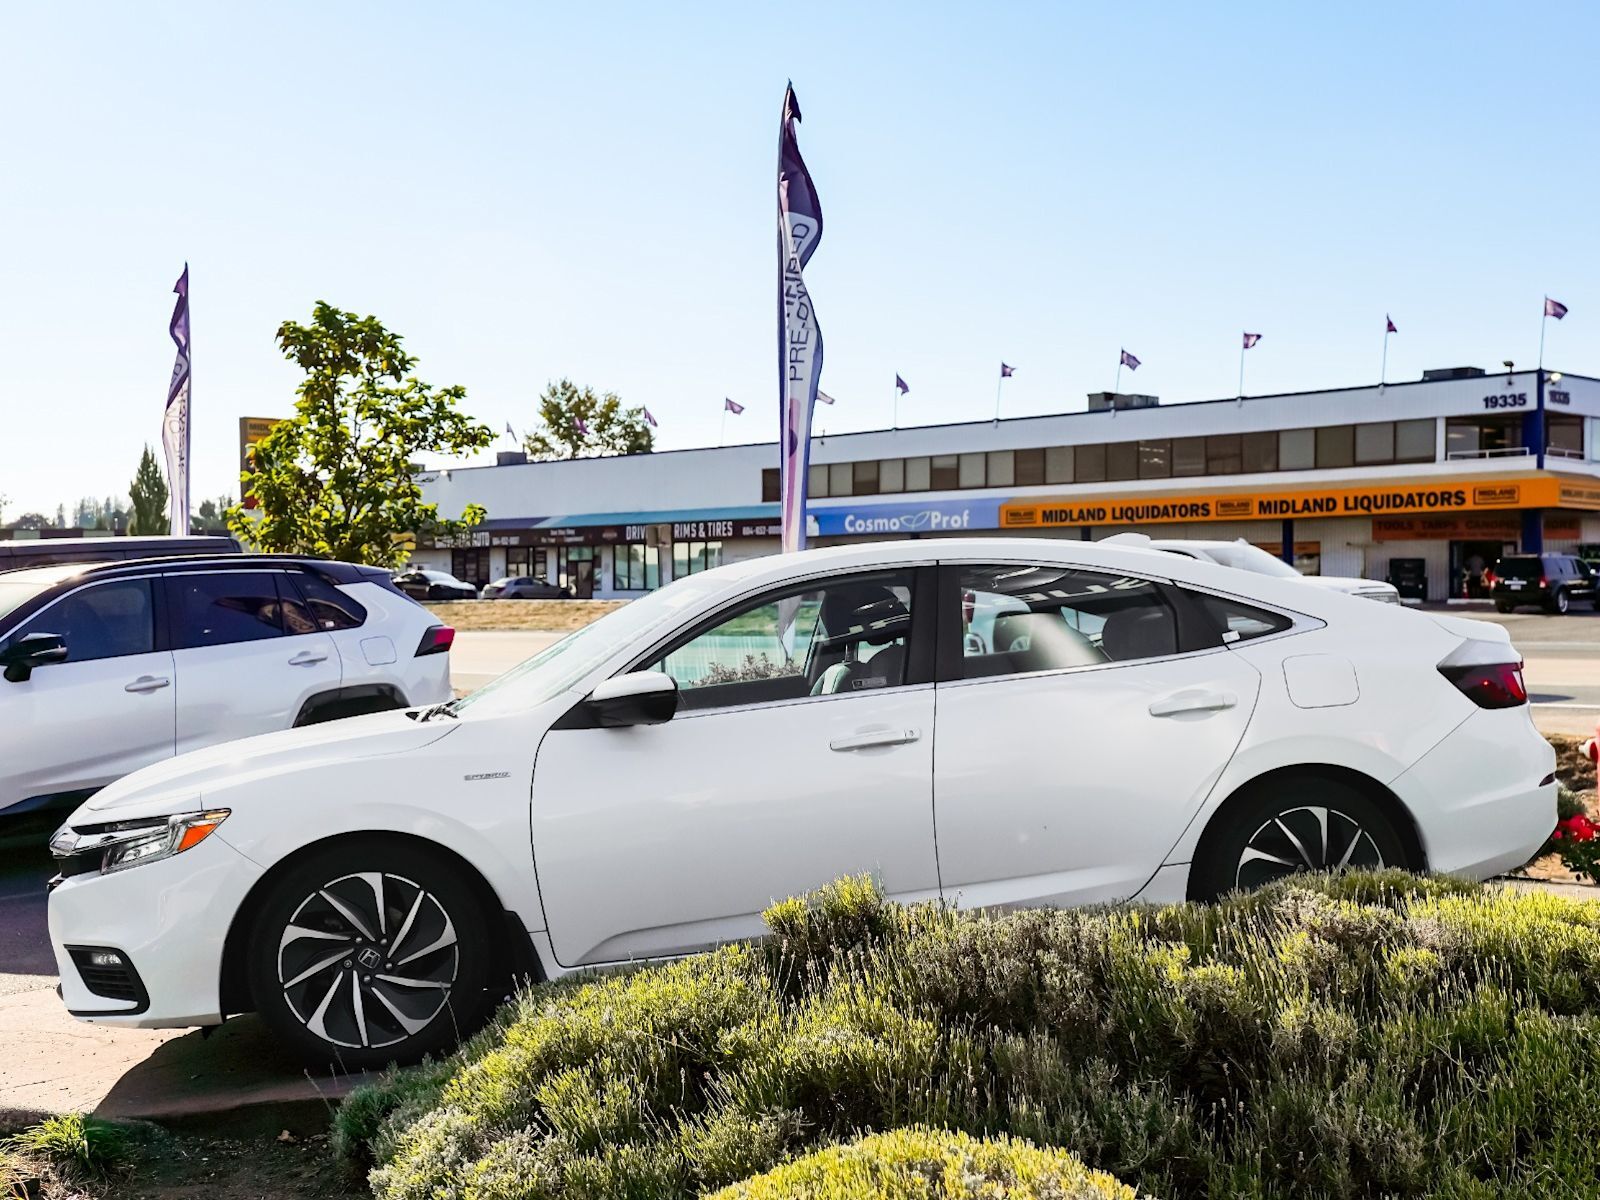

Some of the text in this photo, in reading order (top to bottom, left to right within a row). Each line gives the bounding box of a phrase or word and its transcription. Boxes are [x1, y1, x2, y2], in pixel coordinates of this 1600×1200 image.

[1483, 392, 1527, 409] 19335
[1041, 502, 1211, 523] MIDLAND LIQUIDATORS
[1258, 490, 1466, 515] MIDLAND LIQUIDATORS
[673, 522, 697, 539] RIMS
[698, 522, 706, 538] &
[707, 521, 733, 537] TIRES
[844, 509, 970, 532] Cosmo Prof
